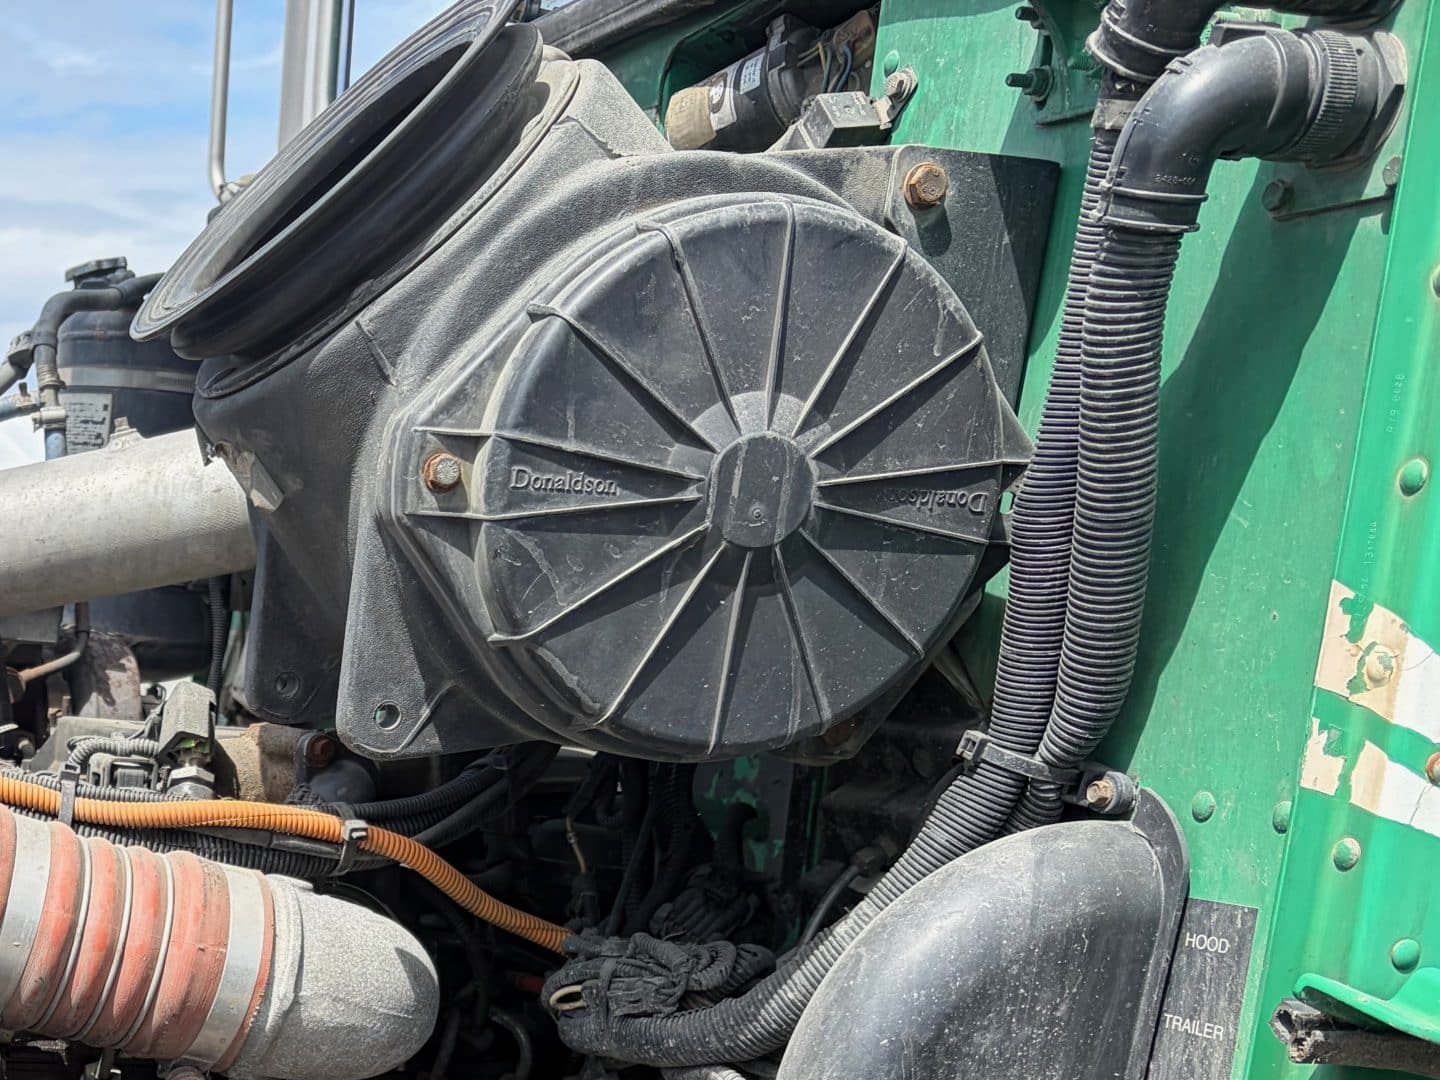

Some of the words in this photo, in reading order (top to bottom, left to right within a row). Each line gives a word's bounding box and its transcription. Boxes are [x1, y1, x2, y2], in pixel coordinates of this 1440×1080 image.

[510, 467, 619, 497] Donaldson
[1184, 931, 1230, 954] HOOD
[1163, 1013, 1225, 1041] TRAILER
